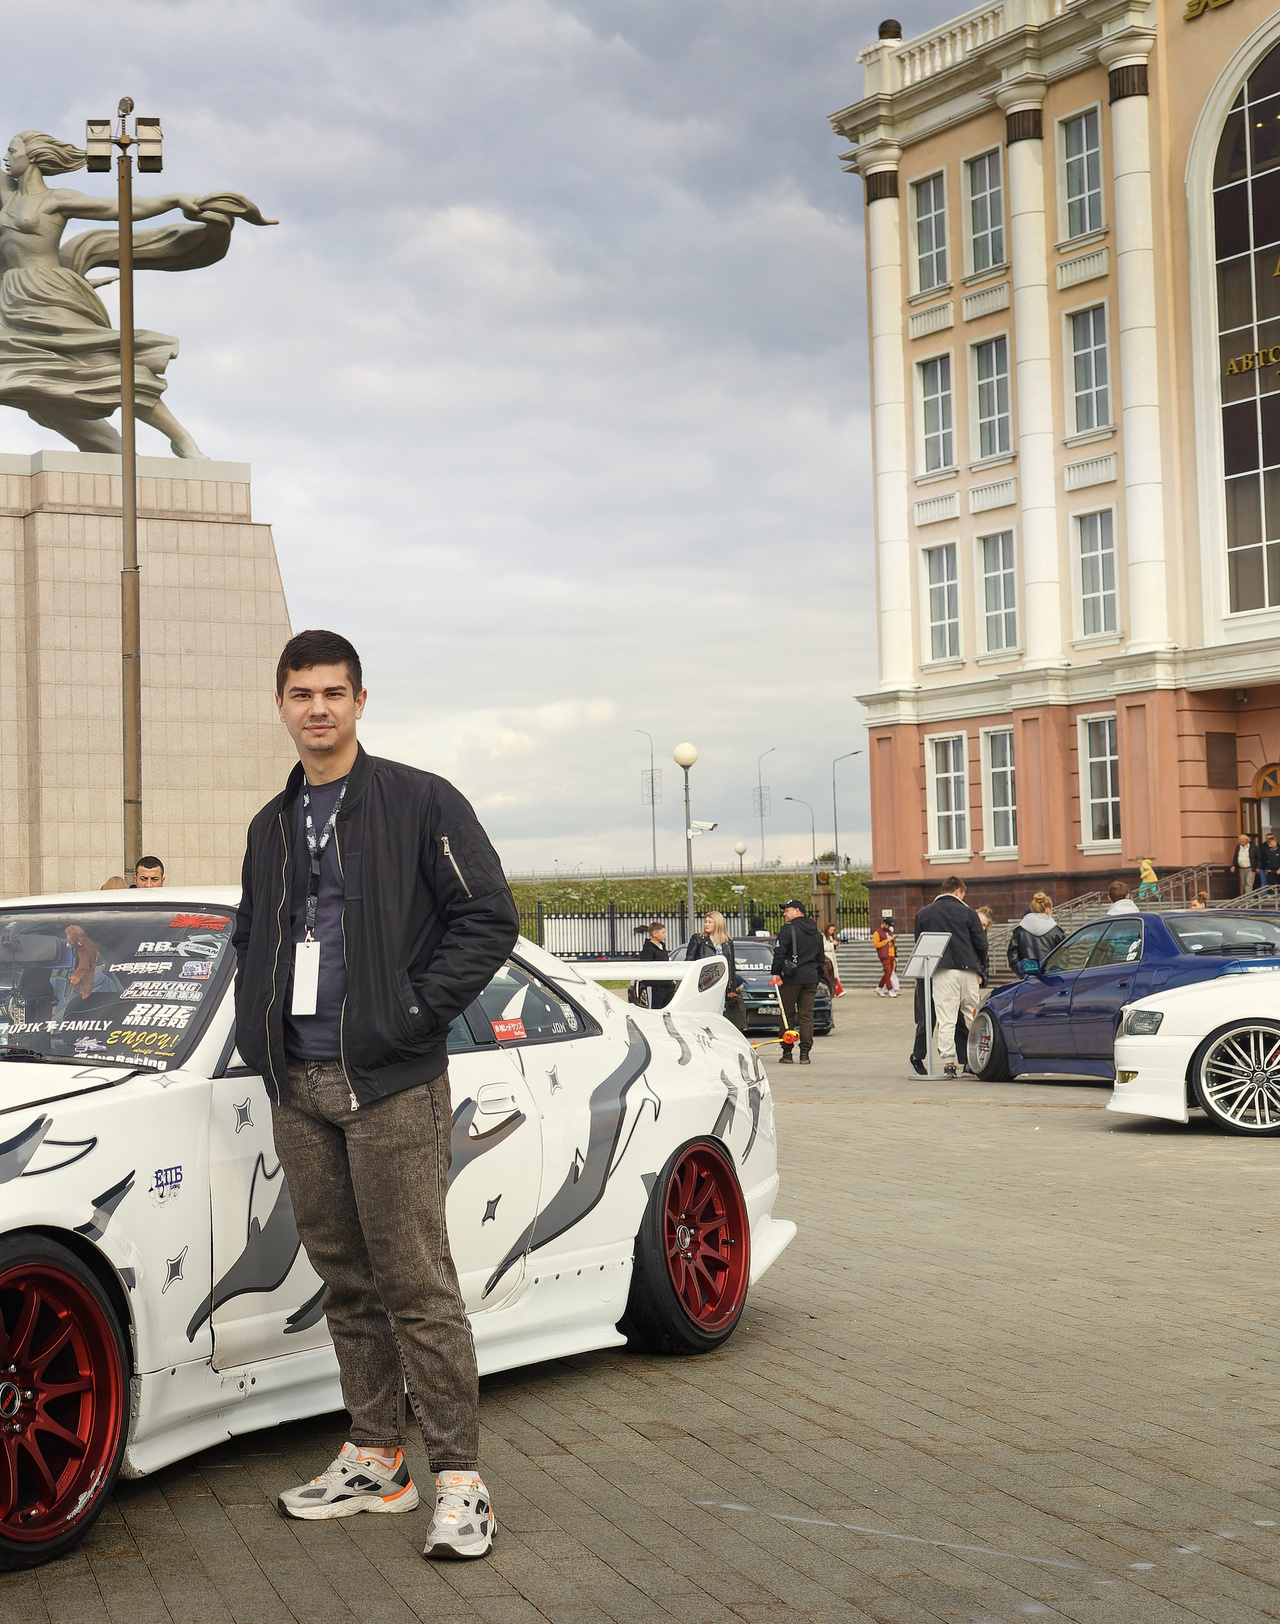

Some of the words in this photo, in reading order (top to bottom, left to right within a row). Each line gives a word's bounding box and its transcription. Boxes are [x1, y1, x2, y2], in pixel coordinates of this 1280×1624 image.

[130, 982, 199, 992] PARKING
[59, 1020, 113, 1031] FAMILY
[106, 1030, 179, 1050] ENJOY!
[154, 1165, 183, 1188] ЕПБ
